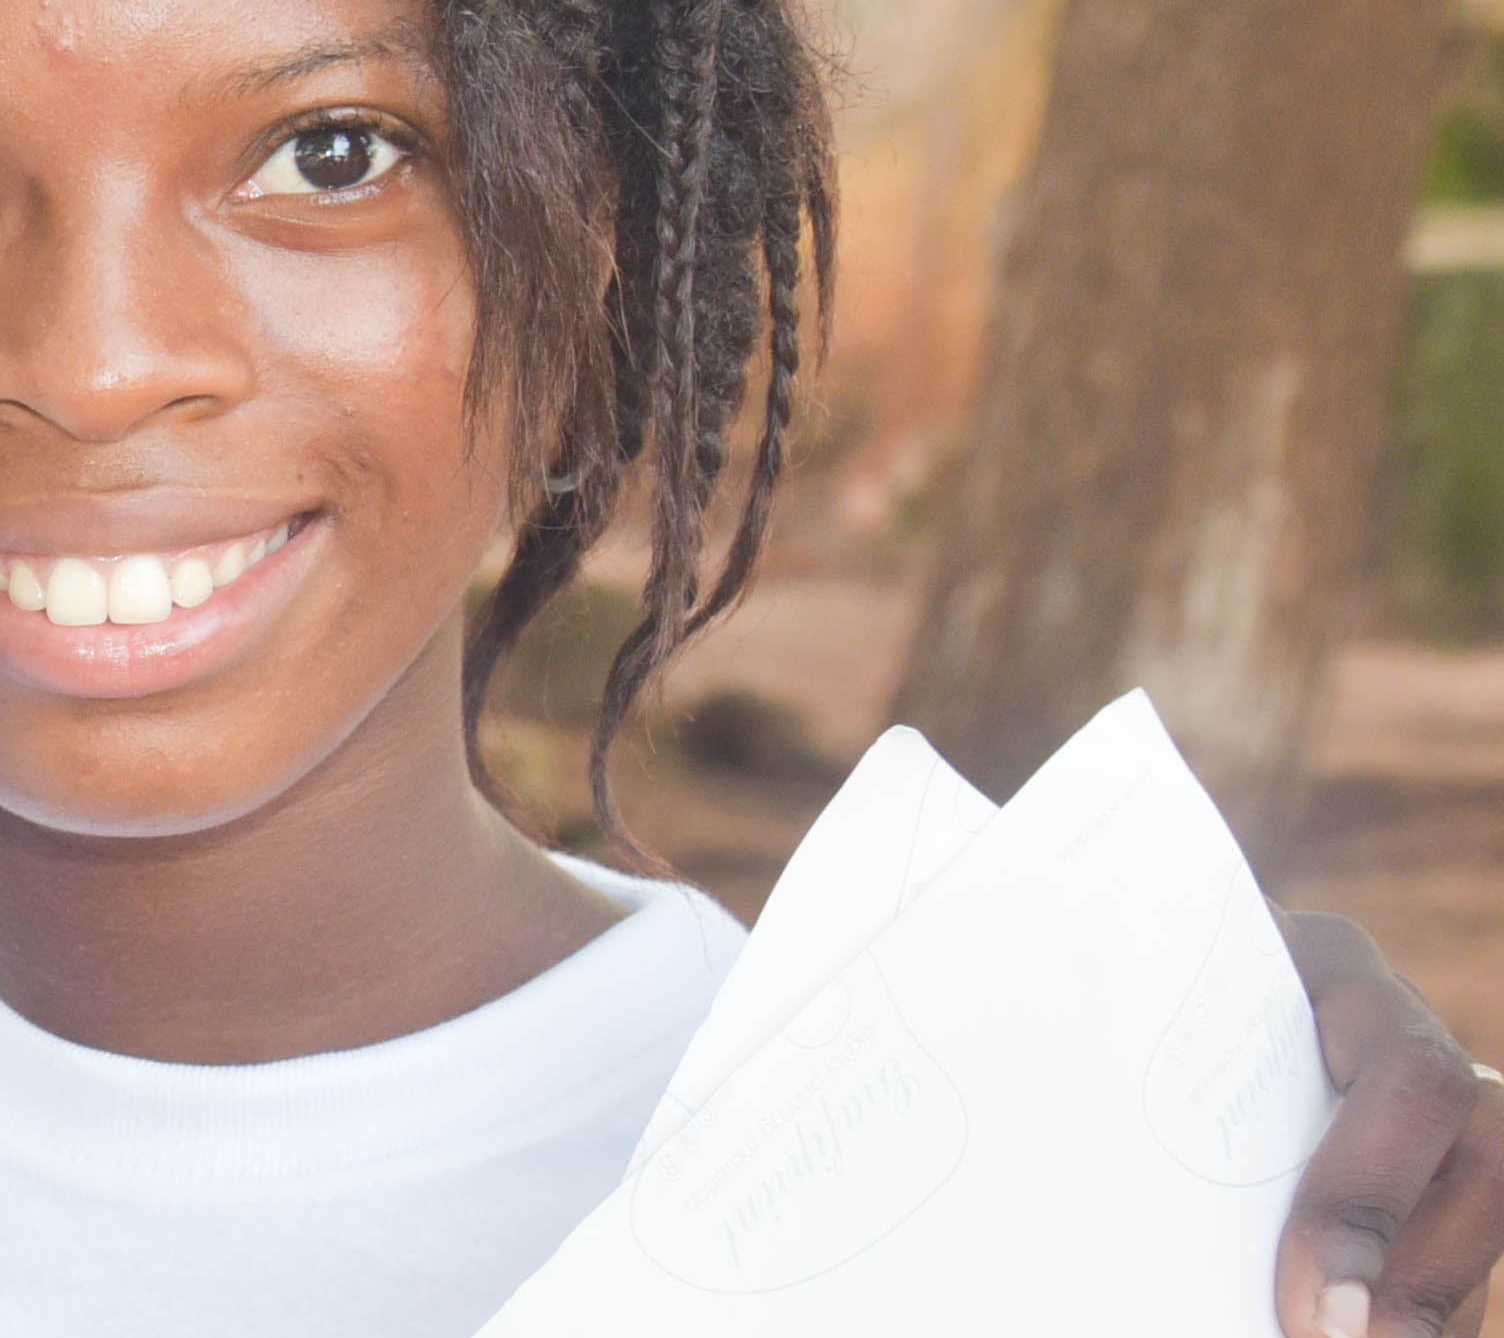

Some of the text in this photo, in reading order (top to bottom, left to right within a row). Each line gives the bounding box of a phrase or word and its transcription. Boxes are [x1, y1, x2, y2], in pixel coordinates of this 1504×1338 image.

[757, 1073, 825, 1137] printing
[683, 1137, 761, 1213] materials
[721, 1058, 921, 1270] Grafiprint
